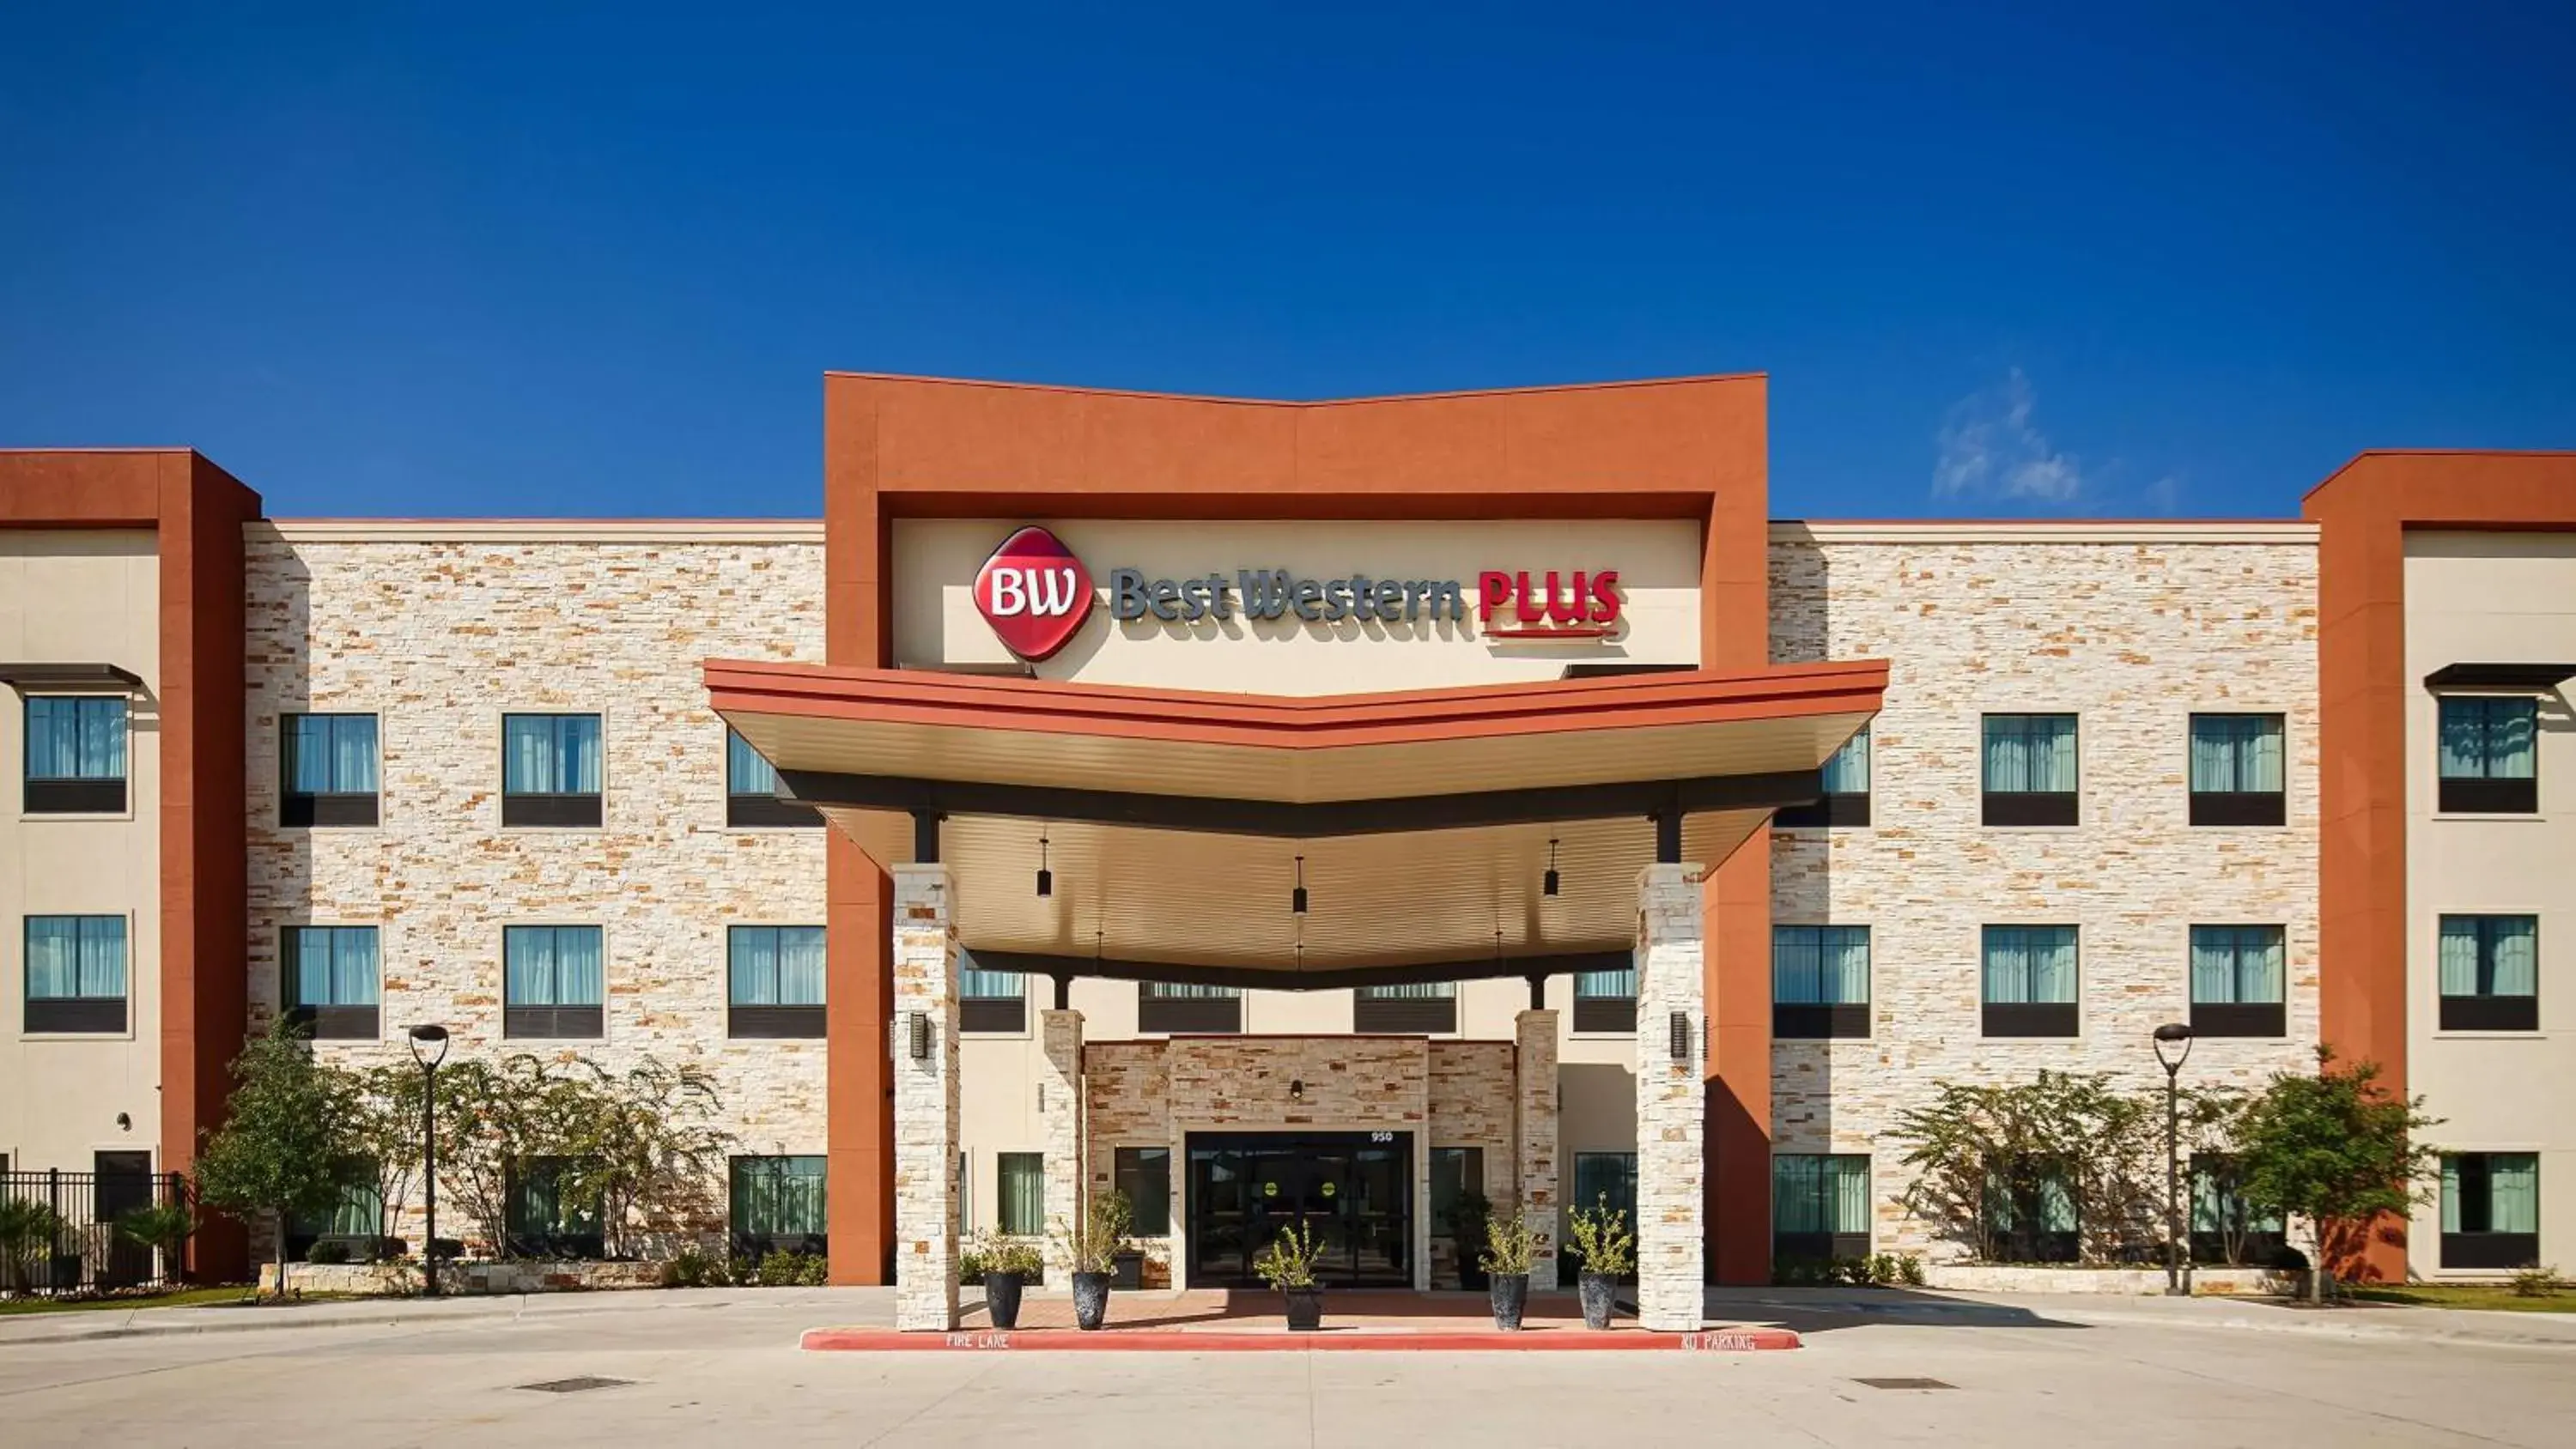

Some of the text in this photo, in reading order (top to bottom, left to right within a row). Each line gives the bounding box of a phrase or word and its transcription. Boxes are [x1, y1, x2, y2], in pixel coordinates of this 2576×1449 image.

[990, 567, 1078, 616] BW
[1111, 568, 1619, 623] Best Western PLUS
[1371, 1131, 1393, 1142] 950
[946, 1333, 1009, 1349] FIRE LANE
[1681, 1332, 1755, 1350] NO PARKING
